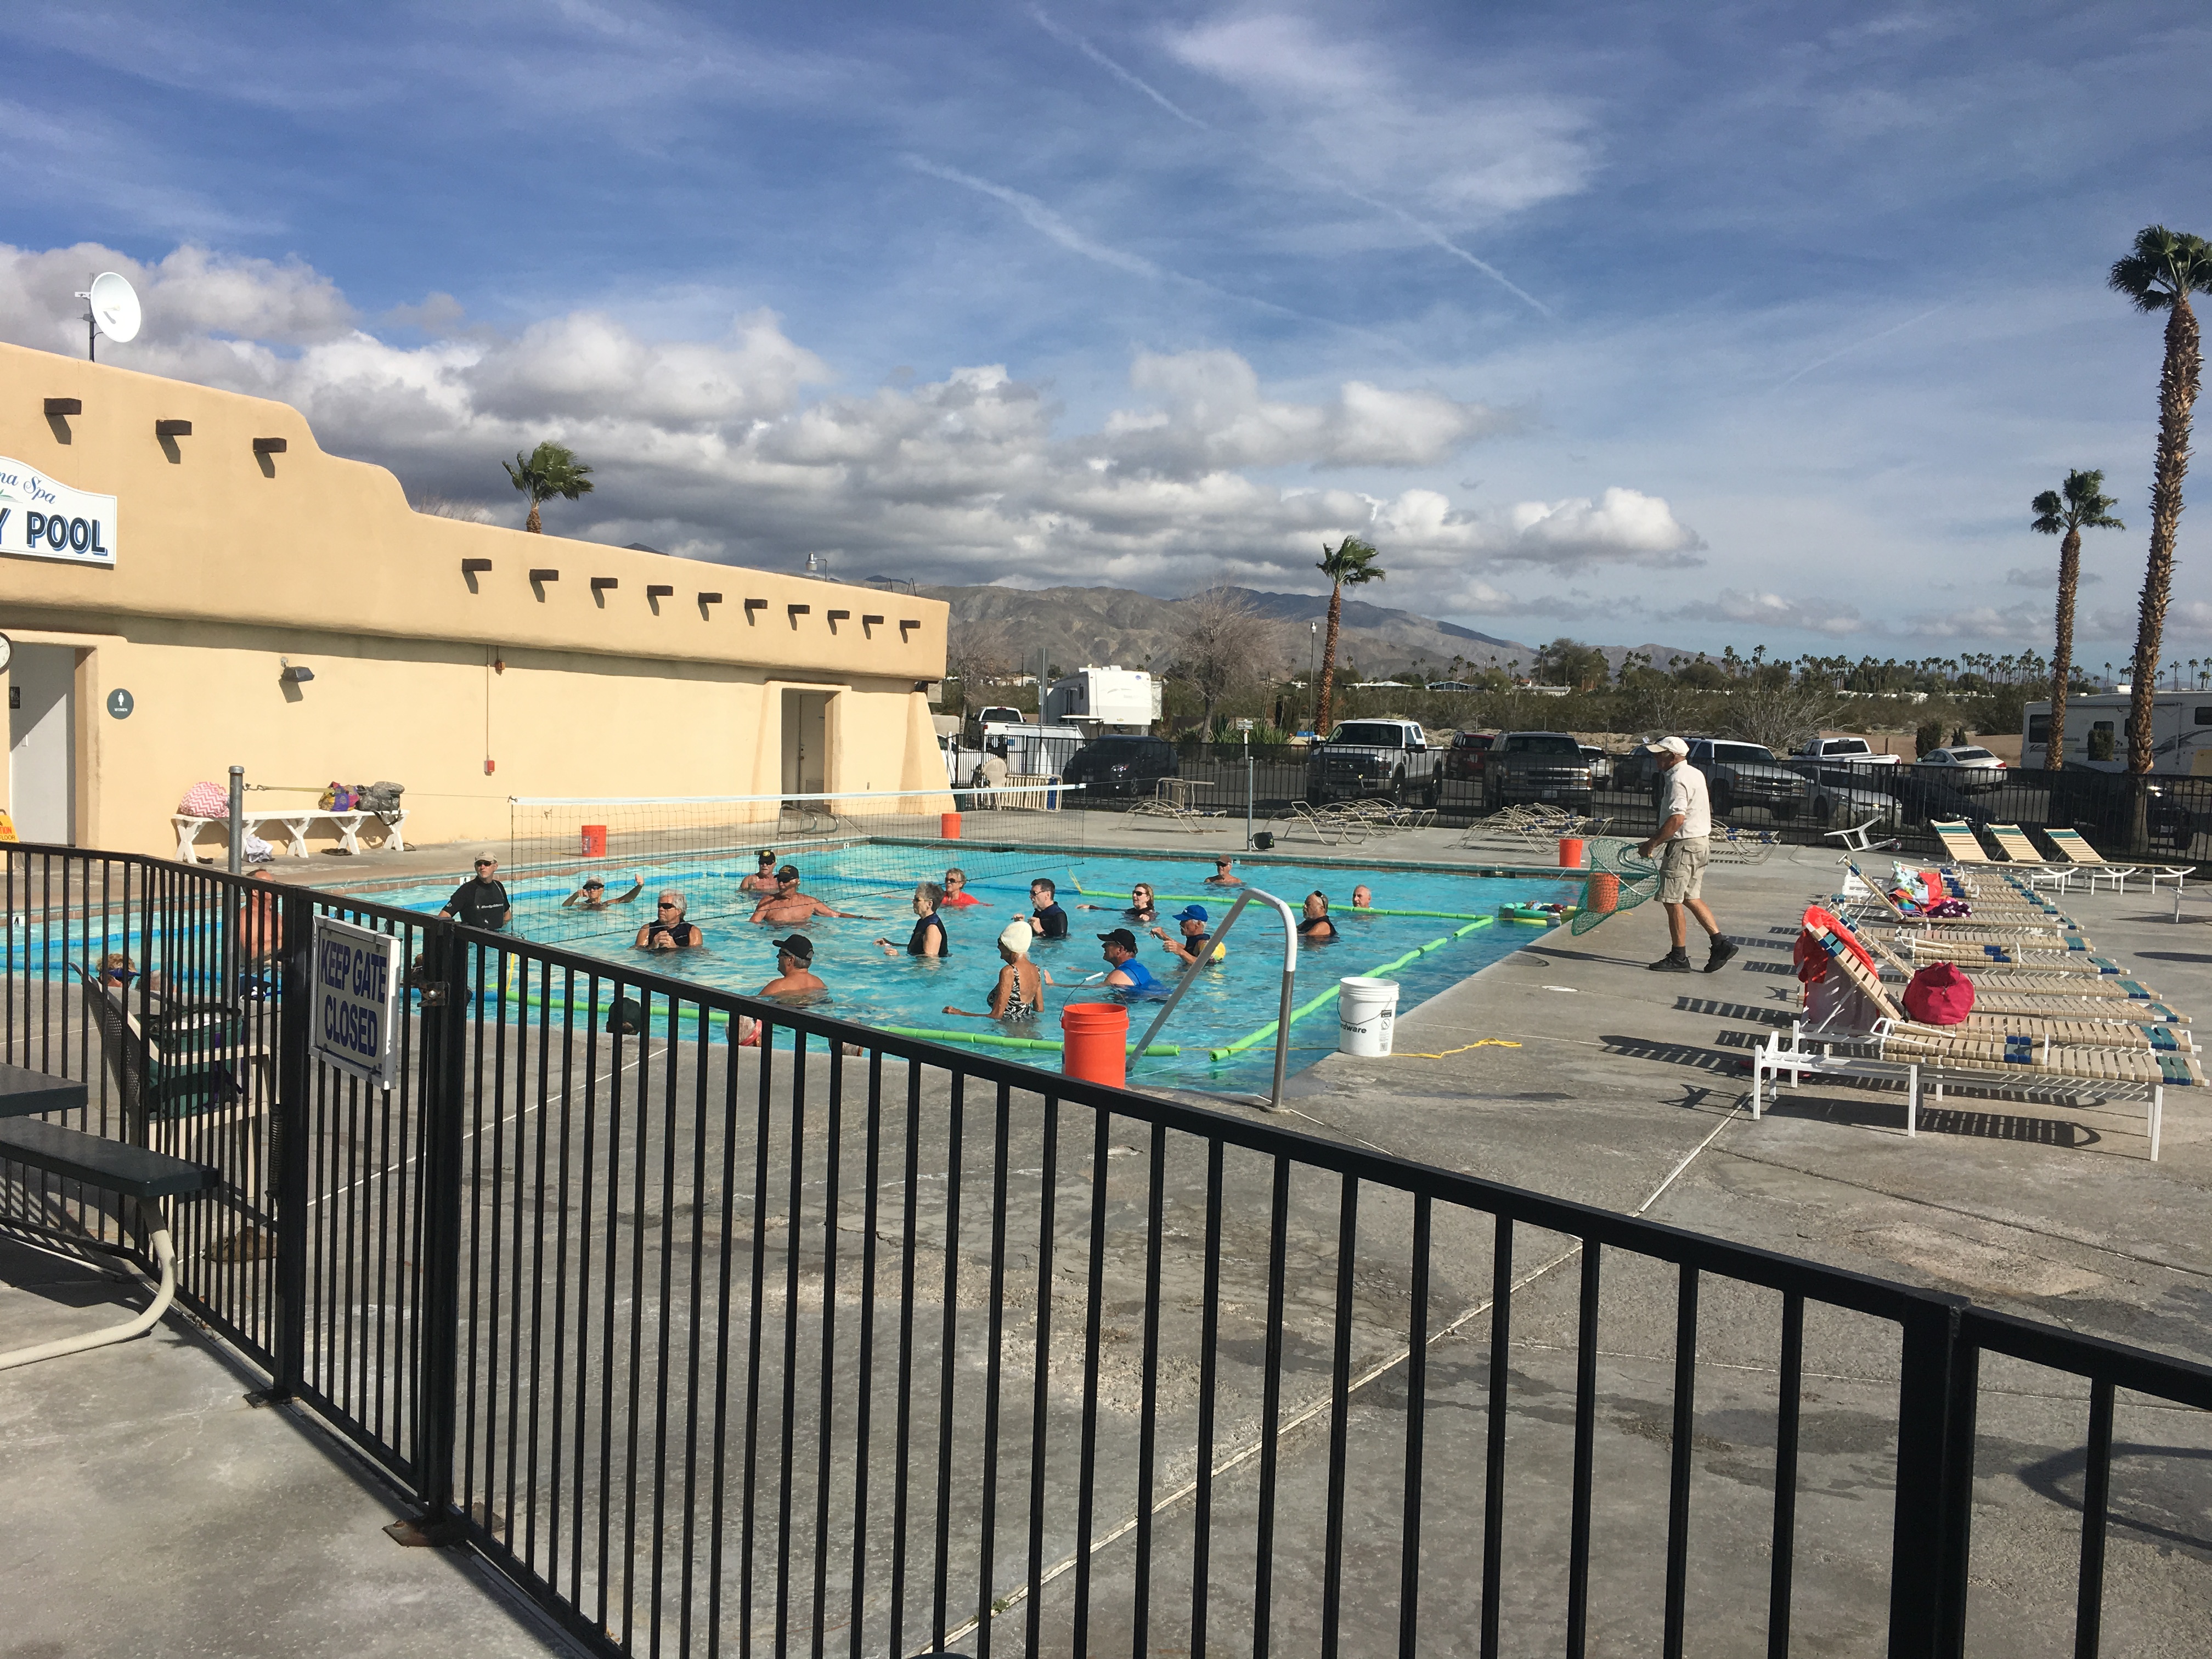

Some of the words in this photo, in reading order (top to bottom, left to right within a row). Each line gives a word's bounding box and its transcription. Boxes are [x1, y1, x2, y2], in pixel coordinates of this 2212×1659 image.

[24, 476, 57, 504] Spa
[26, 511, 108, 556] POOL
[320, 938, 351, 991] KEEP
[353, 949, 387, 1005] GATE
[325, 995, 378, 1058] CLOSED
